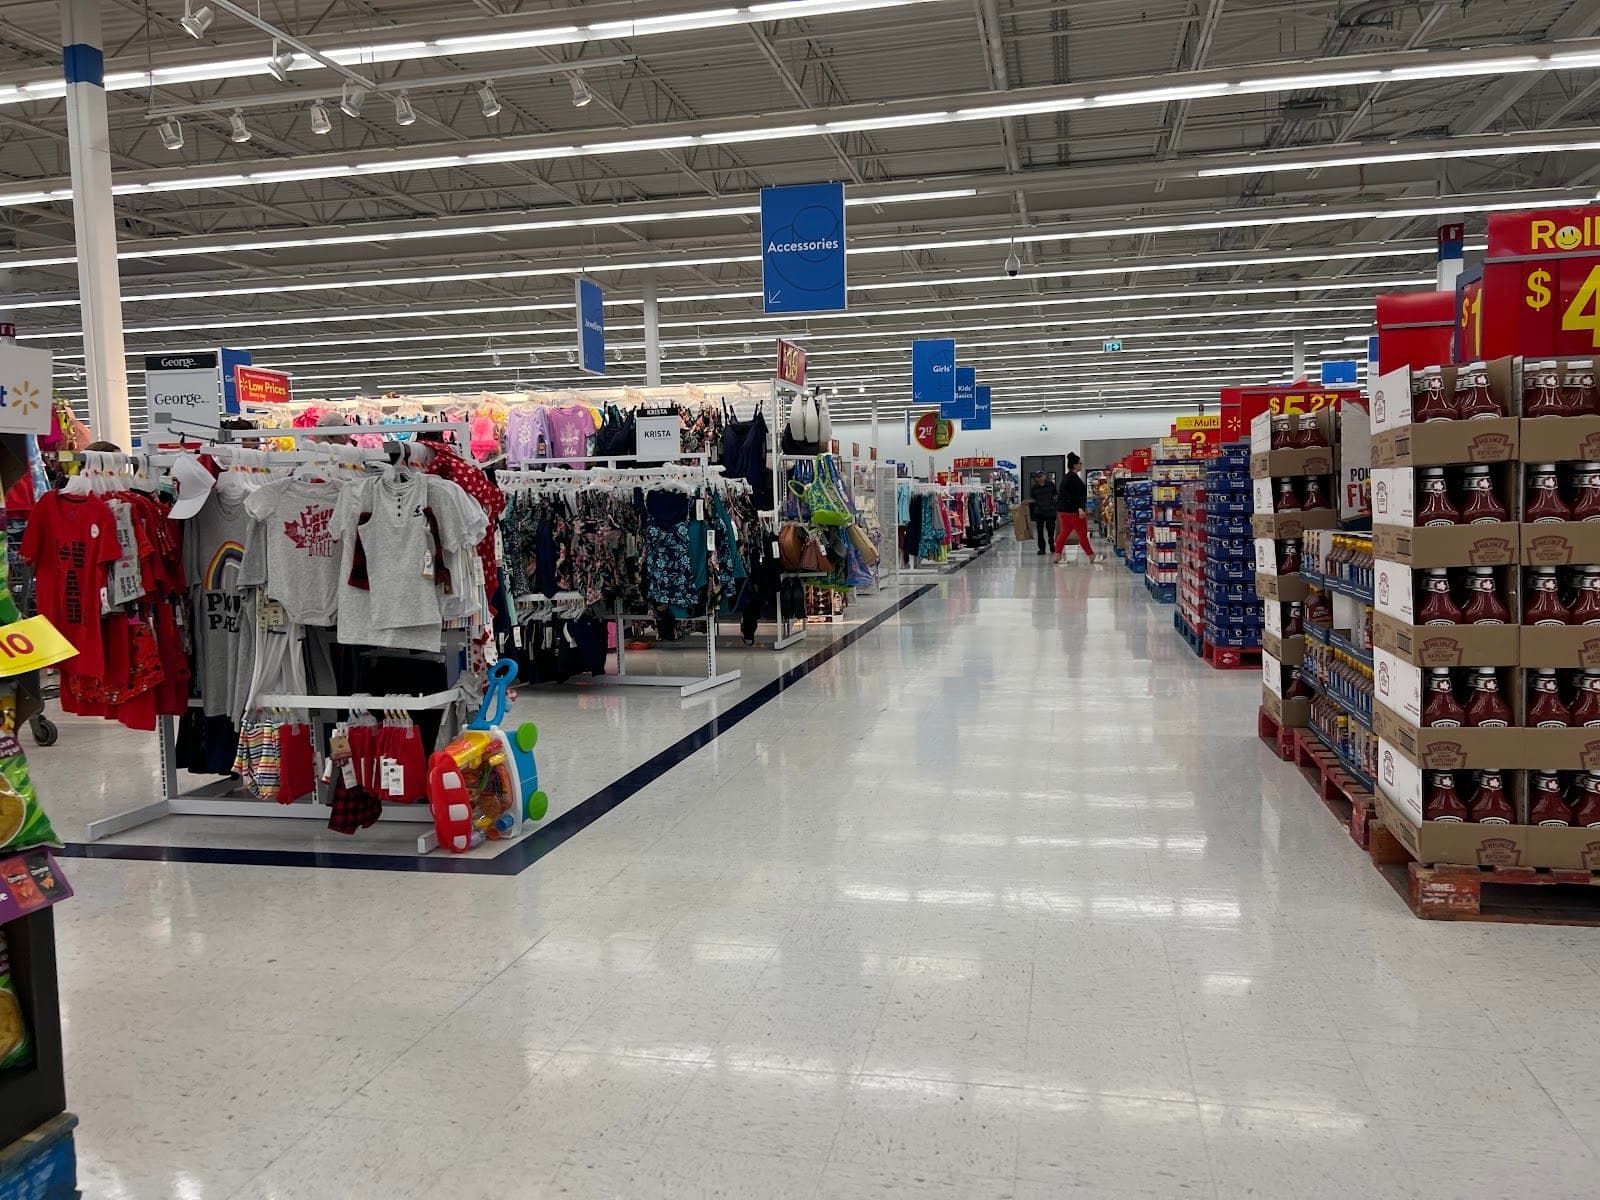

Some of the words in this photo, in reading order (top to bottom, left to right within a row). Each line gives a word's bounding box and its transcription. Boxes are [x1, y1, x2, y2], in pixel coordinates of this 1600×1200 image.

[767, 238, 839, 253] Accessories
[932, 364, 952, 373] Girls'
[248, 380, 263, 392] Low
[264, 382, 286, 395] Prices
[1193, 416, 1219, 427] Multi
[644, 430, 671, 439] KRISTA
